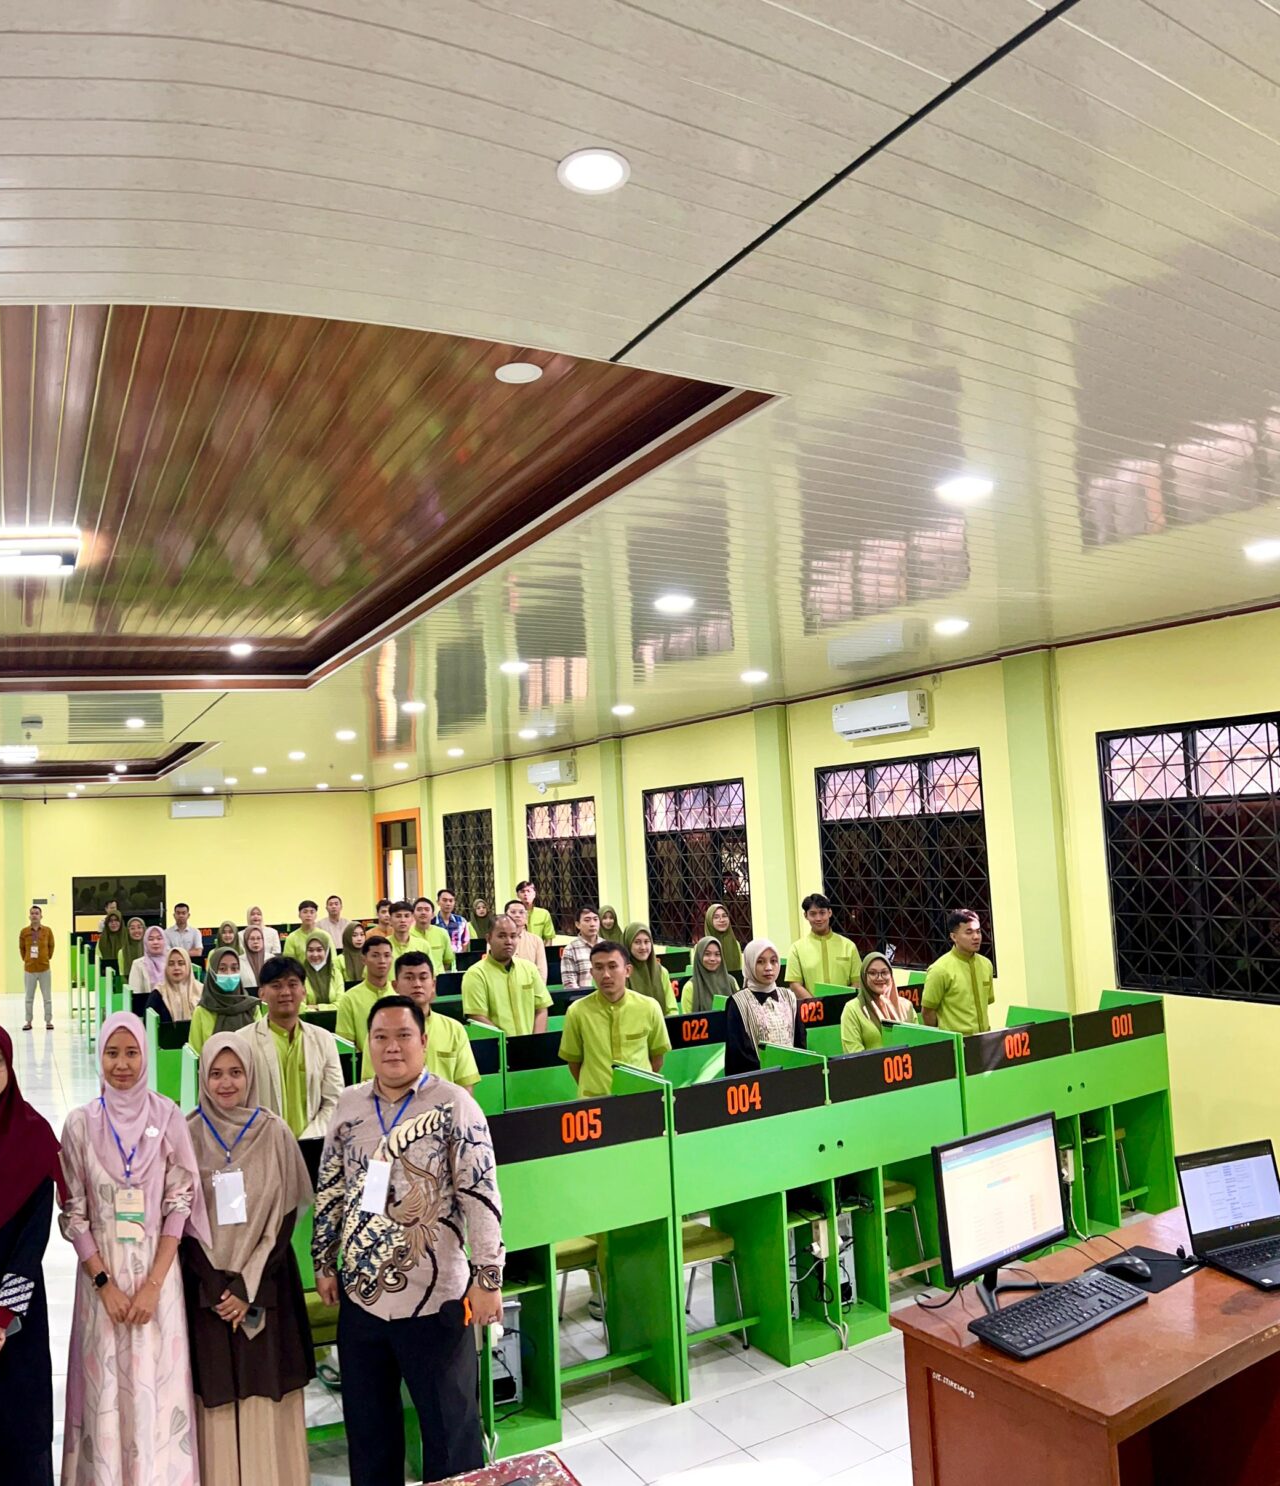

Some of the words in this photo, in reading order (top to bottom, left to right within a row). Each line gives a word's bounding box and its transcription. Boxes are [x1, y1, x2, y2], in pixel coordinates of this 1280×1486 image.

[800, 1001, 824, 1023] 023
[1111, 1014, 1133, 1038] 001
[682, 1018, 709, 1041] 022
[1004, 1031, 1031, 1060] 002
[883, 1053, 913, 1083] 003
[727, 1082, 762, 1115] 004
[561, 1108, 602, 1144] 005
